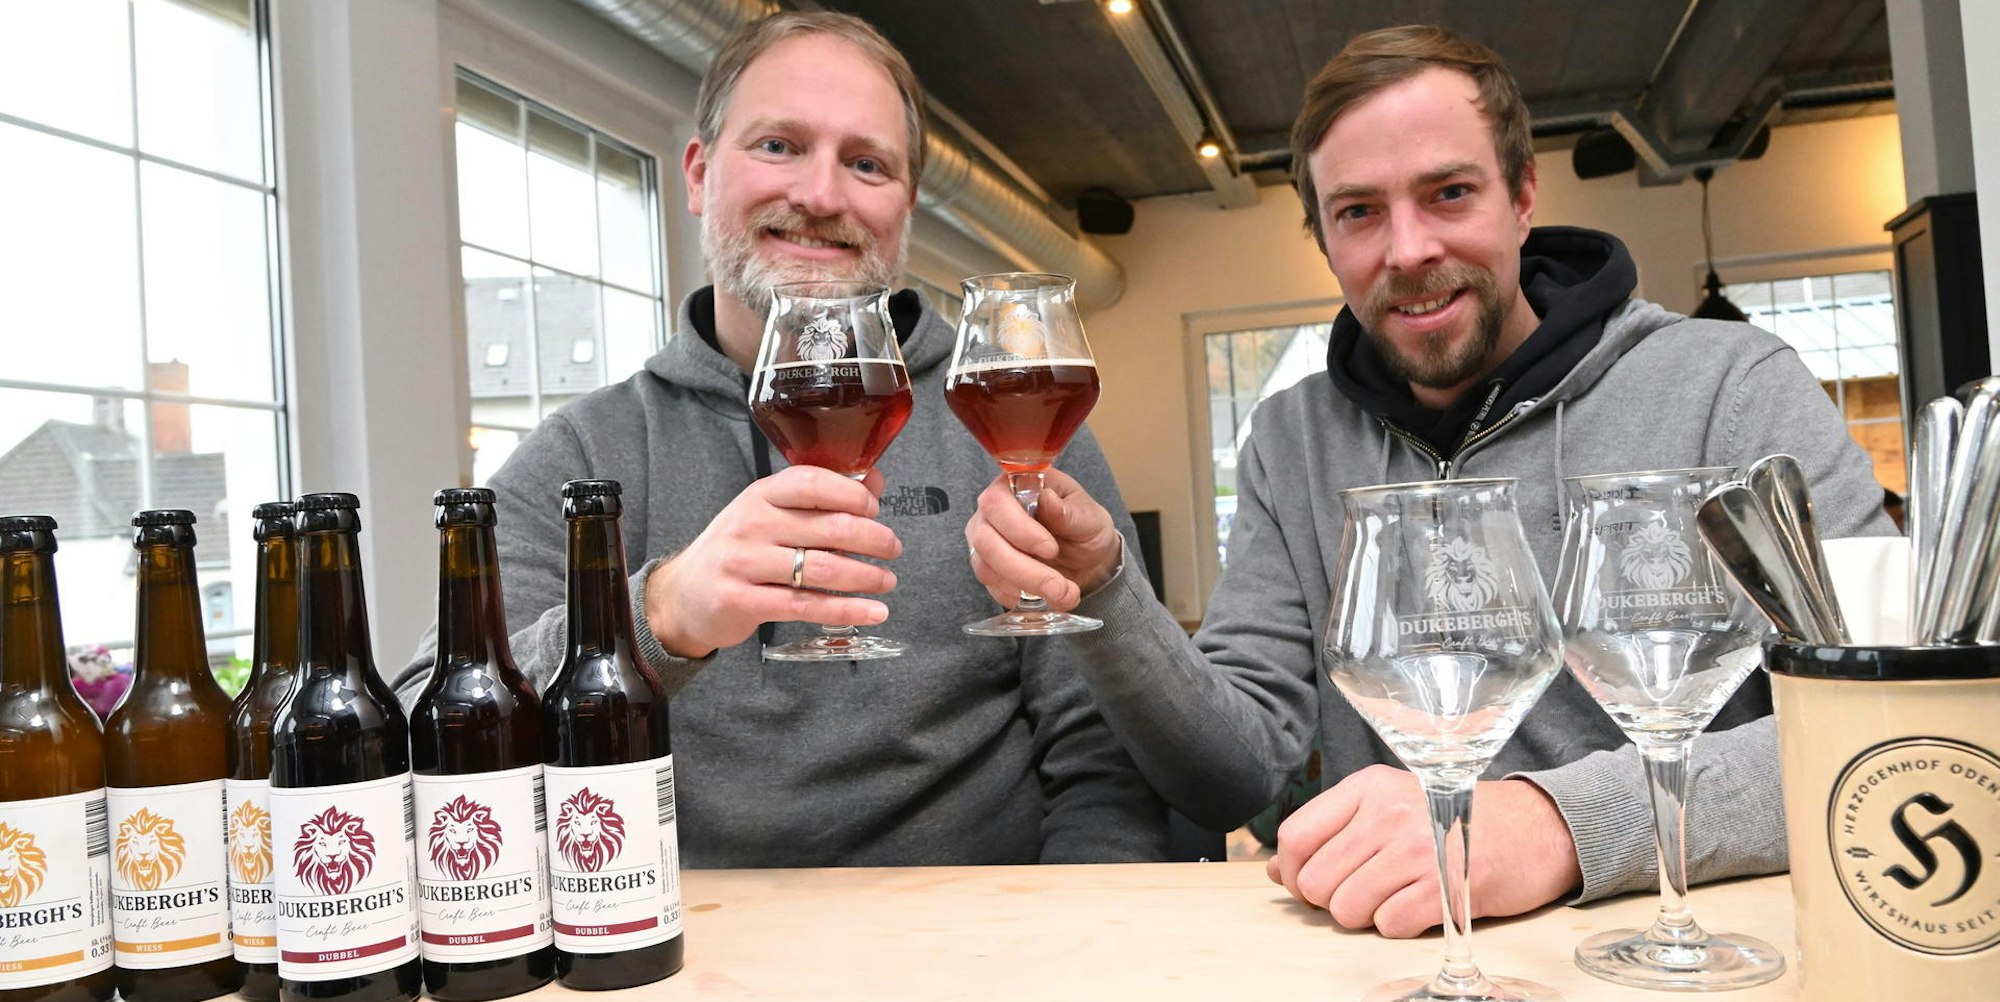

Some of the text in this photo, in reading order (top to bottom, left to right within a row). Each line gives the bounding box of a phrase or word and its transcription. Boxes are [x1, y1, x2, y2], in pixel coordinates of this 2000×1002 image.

[899, 485, 923, 497] THE
[879, 495, 926, 507] NORTH
[893, 506, 926, 517] FACE
[1400, 610, 1532, 636] DUKEBERGH'S
[1844, 760, 2000, 835] HERZOGENHOF ODEN
[419, 876, 532, 902] DUKEBERGH'S
[278, 887, 404, 919] DUKEBERGH'S
[1855, 869, 1996, 934] WIRTSHAUS SEIT
[437, 906, 496, 925] Craft Beer
[124, 917, 178, 933] Craft Beer
[305, 920, 370, 941] Craft Beer
[575, 927, 610, 936] DUBBEL
[136, 943, 164, 953] WIESS
[449, 935, 486, 945] DUBBEL
[318, 949, 360, 962] DUBBEL
